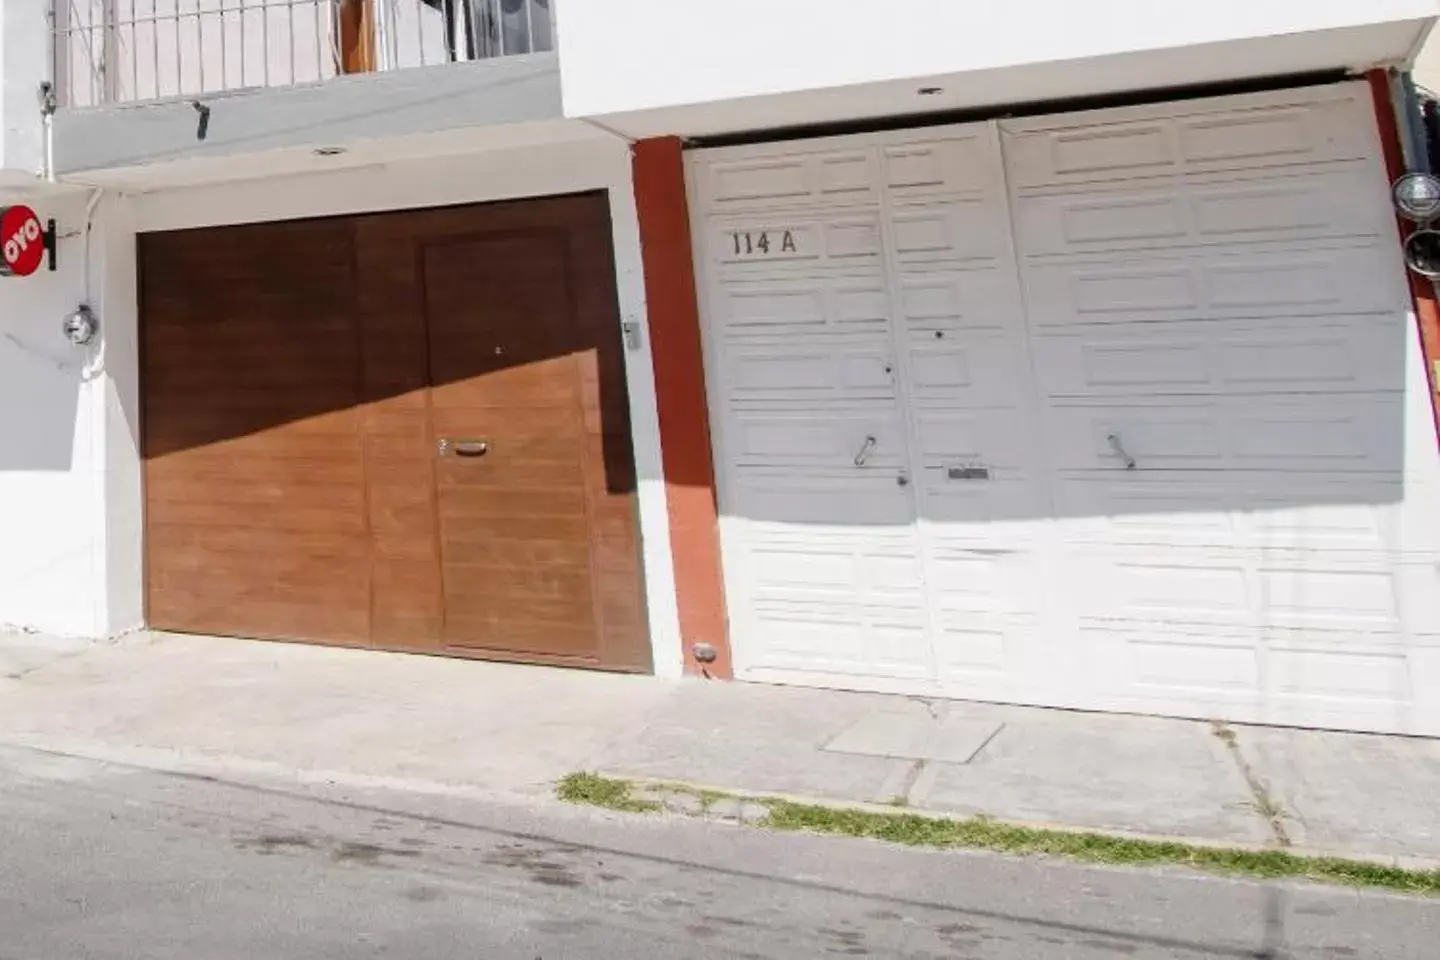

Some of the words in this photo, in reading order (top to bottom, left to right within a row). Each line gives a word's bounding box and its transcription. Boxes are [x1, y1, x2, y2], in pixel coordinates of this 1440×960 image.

[4, 218, 39, 264] OYO
[733, 231, 770, 254] 114
[780, 230, 797, 253] A
